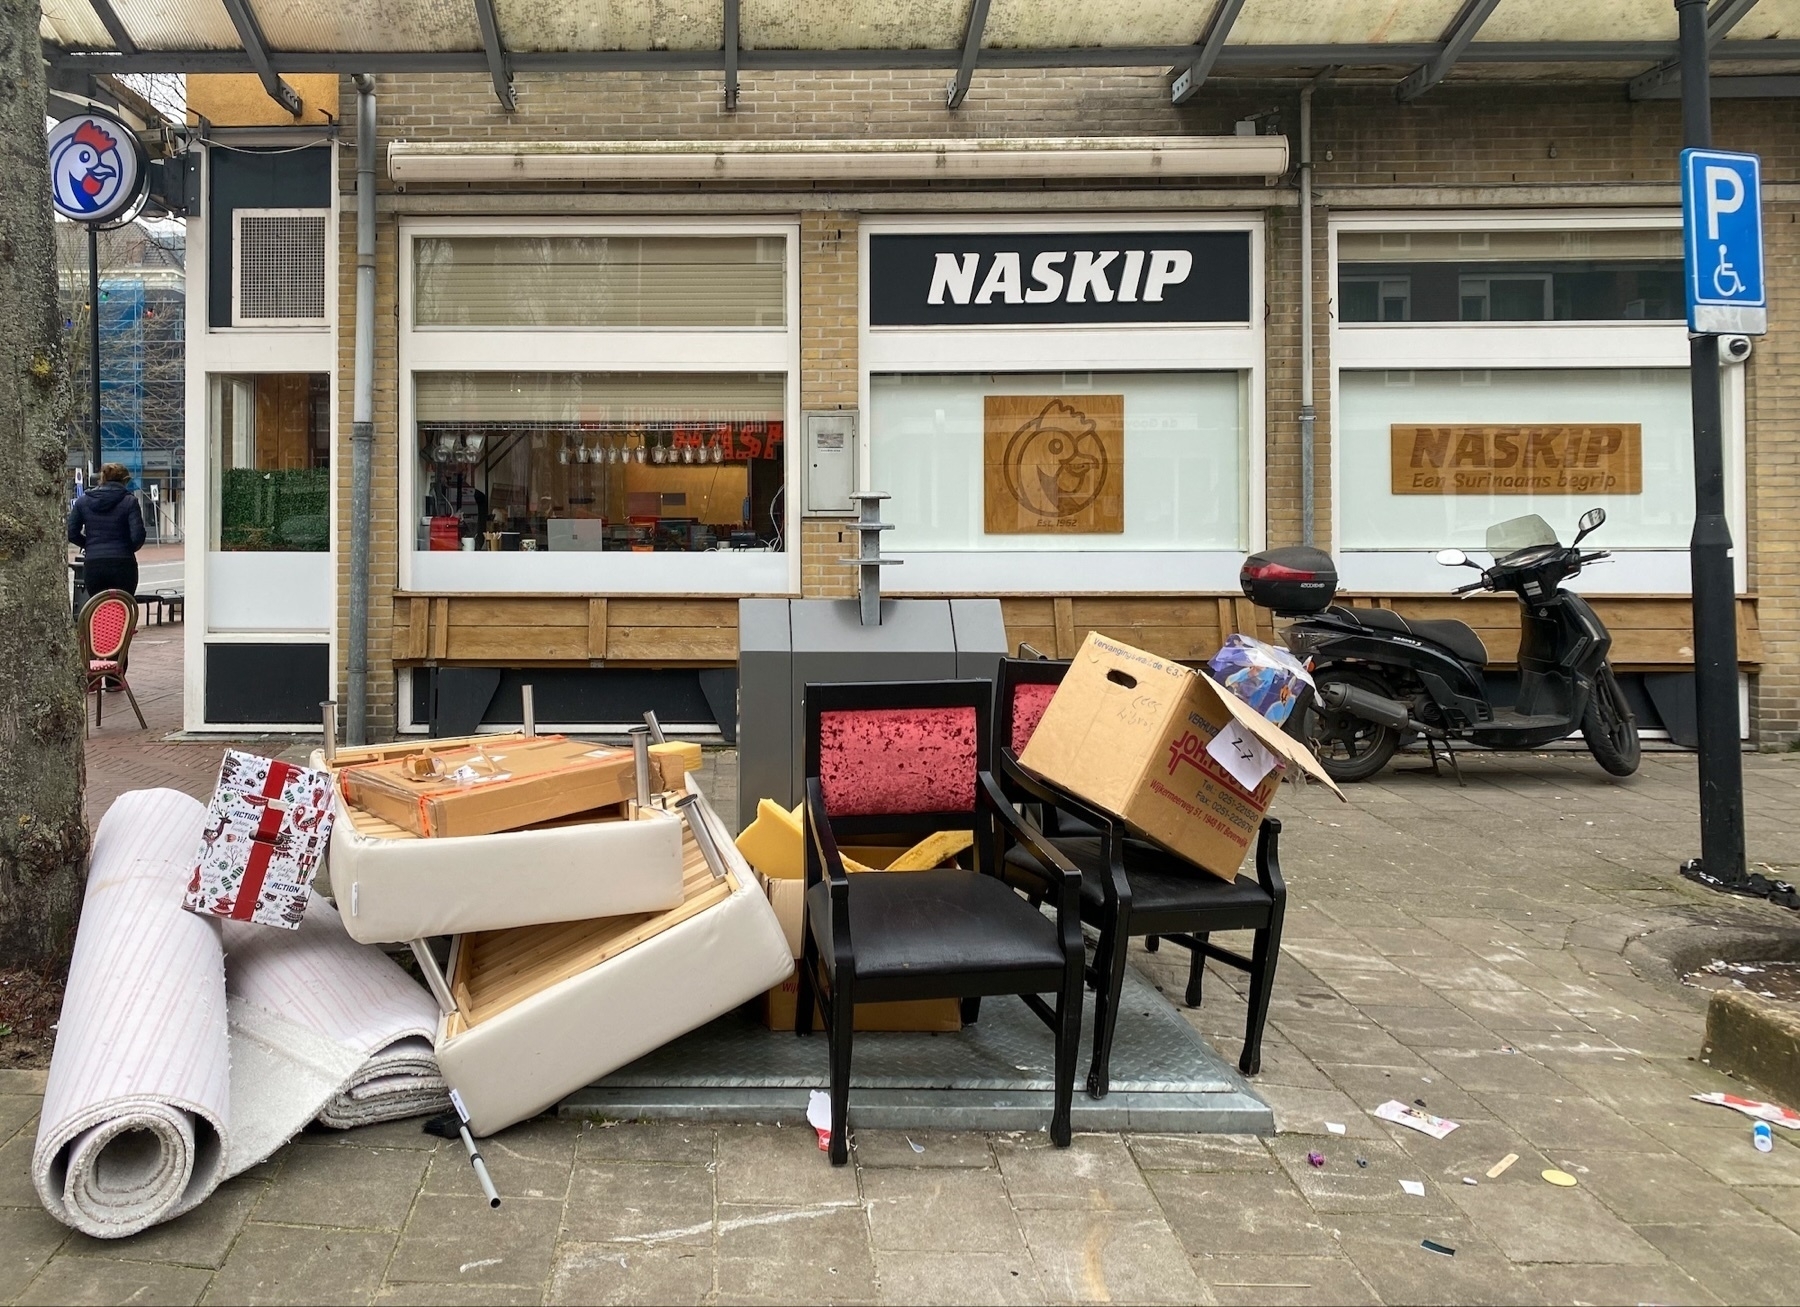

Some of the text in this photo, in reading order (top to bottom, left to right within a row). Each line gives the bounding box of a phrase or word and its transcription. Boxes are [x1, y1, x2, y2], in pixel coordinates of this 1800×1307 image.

[1705, 165, 1745, 240] P
[926, 249, 1194, 305] NASKIP
[1409, 427, 1623, 469] NASKIP
[1412, 470, 1617, 491] Een Surinaams begrip
[1056, 519, 1078, 527] 1962
[1093, 638, 1163, 670] Vervangingswade
[1187, 711, 1221, 738] VERHUIZ
[233, 810, 260, 822] ACTION
[1149, 778, 1195, 815] Wijkermeerweg
[1215, 820, 1226, 833] NT
[1223, 825, 1249, 848] Beverwijk
[1195, 790, 1254, 833] Fax: 0251-222976
[1217, 792, 1259, 822] 0251-221520
[271, 881, 301, 894] ACTION
